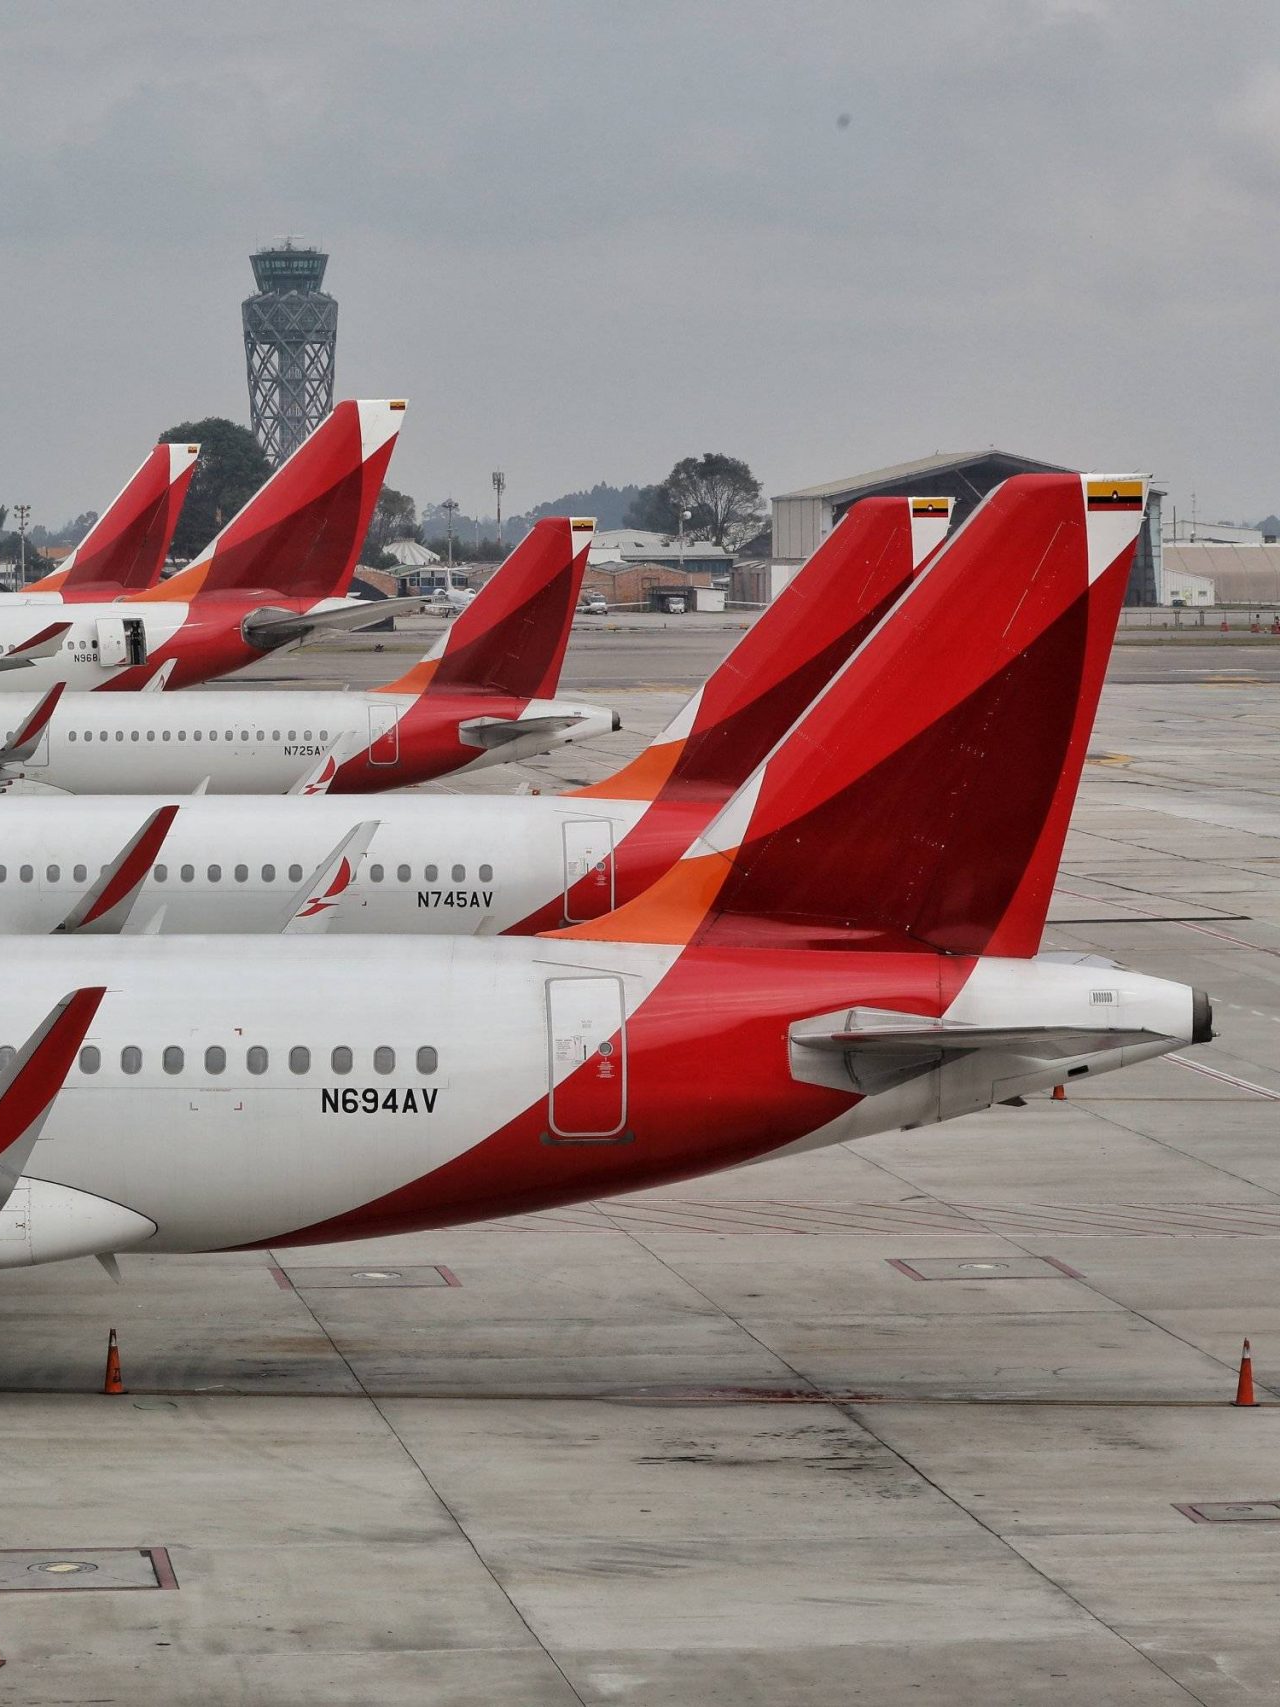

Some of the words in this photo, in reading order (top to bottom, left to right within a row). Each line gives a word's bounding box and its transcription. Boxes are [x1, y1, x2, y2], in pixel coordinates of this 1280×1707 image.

[74, 653, 101, 663] N968
[417, 890, 494, 908] N745AV
[321, 1087, 439, 1114] N694AV
